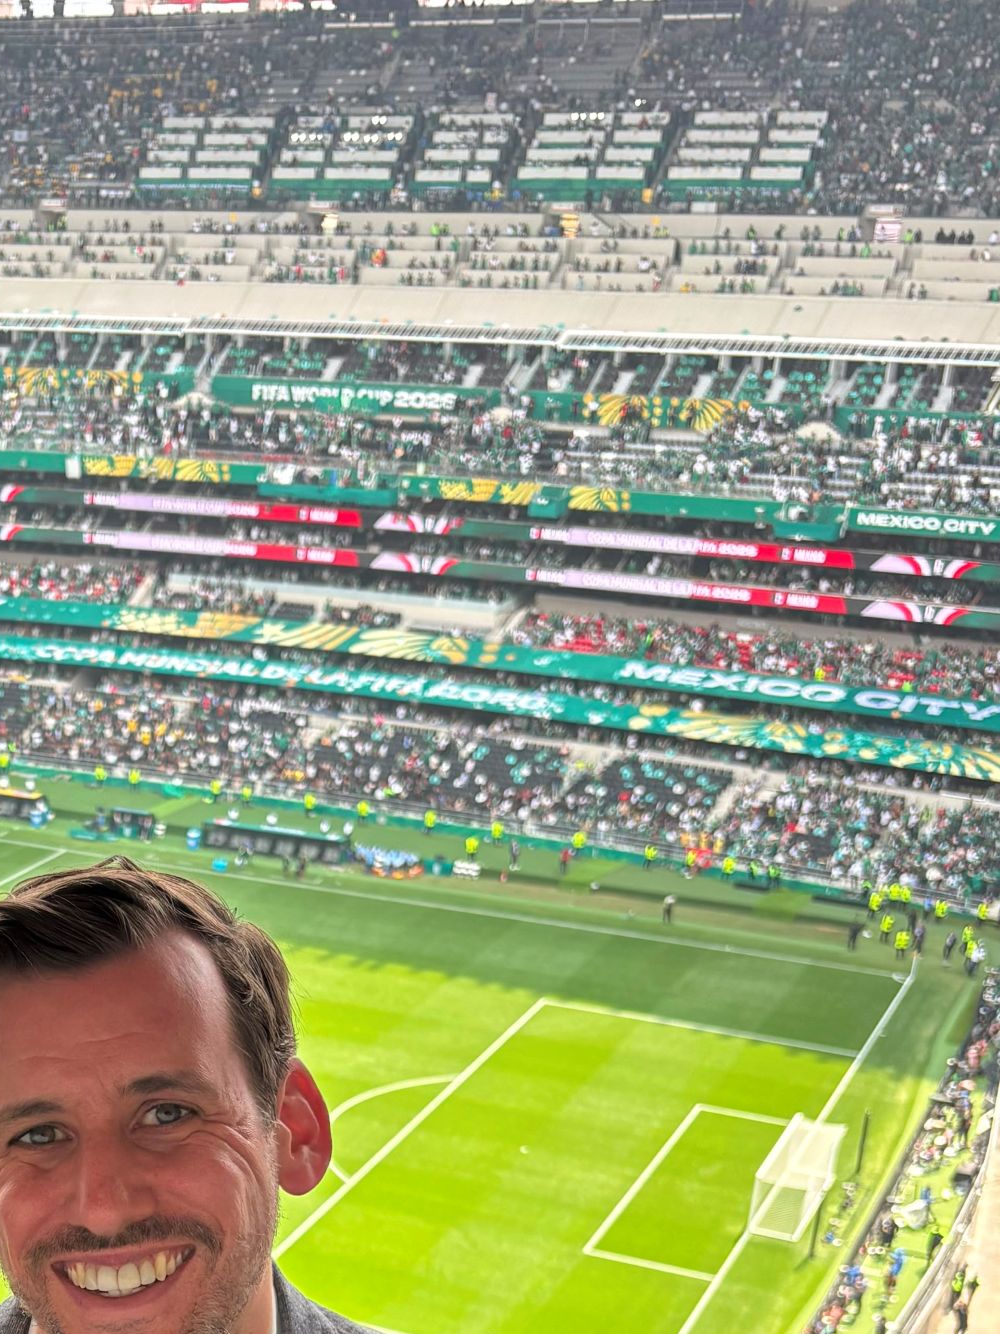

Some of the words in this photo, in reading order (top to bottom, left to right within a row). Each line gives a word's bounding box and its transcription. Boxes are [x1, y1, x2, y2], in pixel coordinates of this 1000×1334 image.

[251, 384, 290, 402] FIFA
[394, 390, 458, 410] 2026
[857, 512, 942, 531] MEXICO
[943, 518, 997, 536] CITY
[618, 660, 848, 702] MEXICO
[854, 690, 1000, 721] CITY
